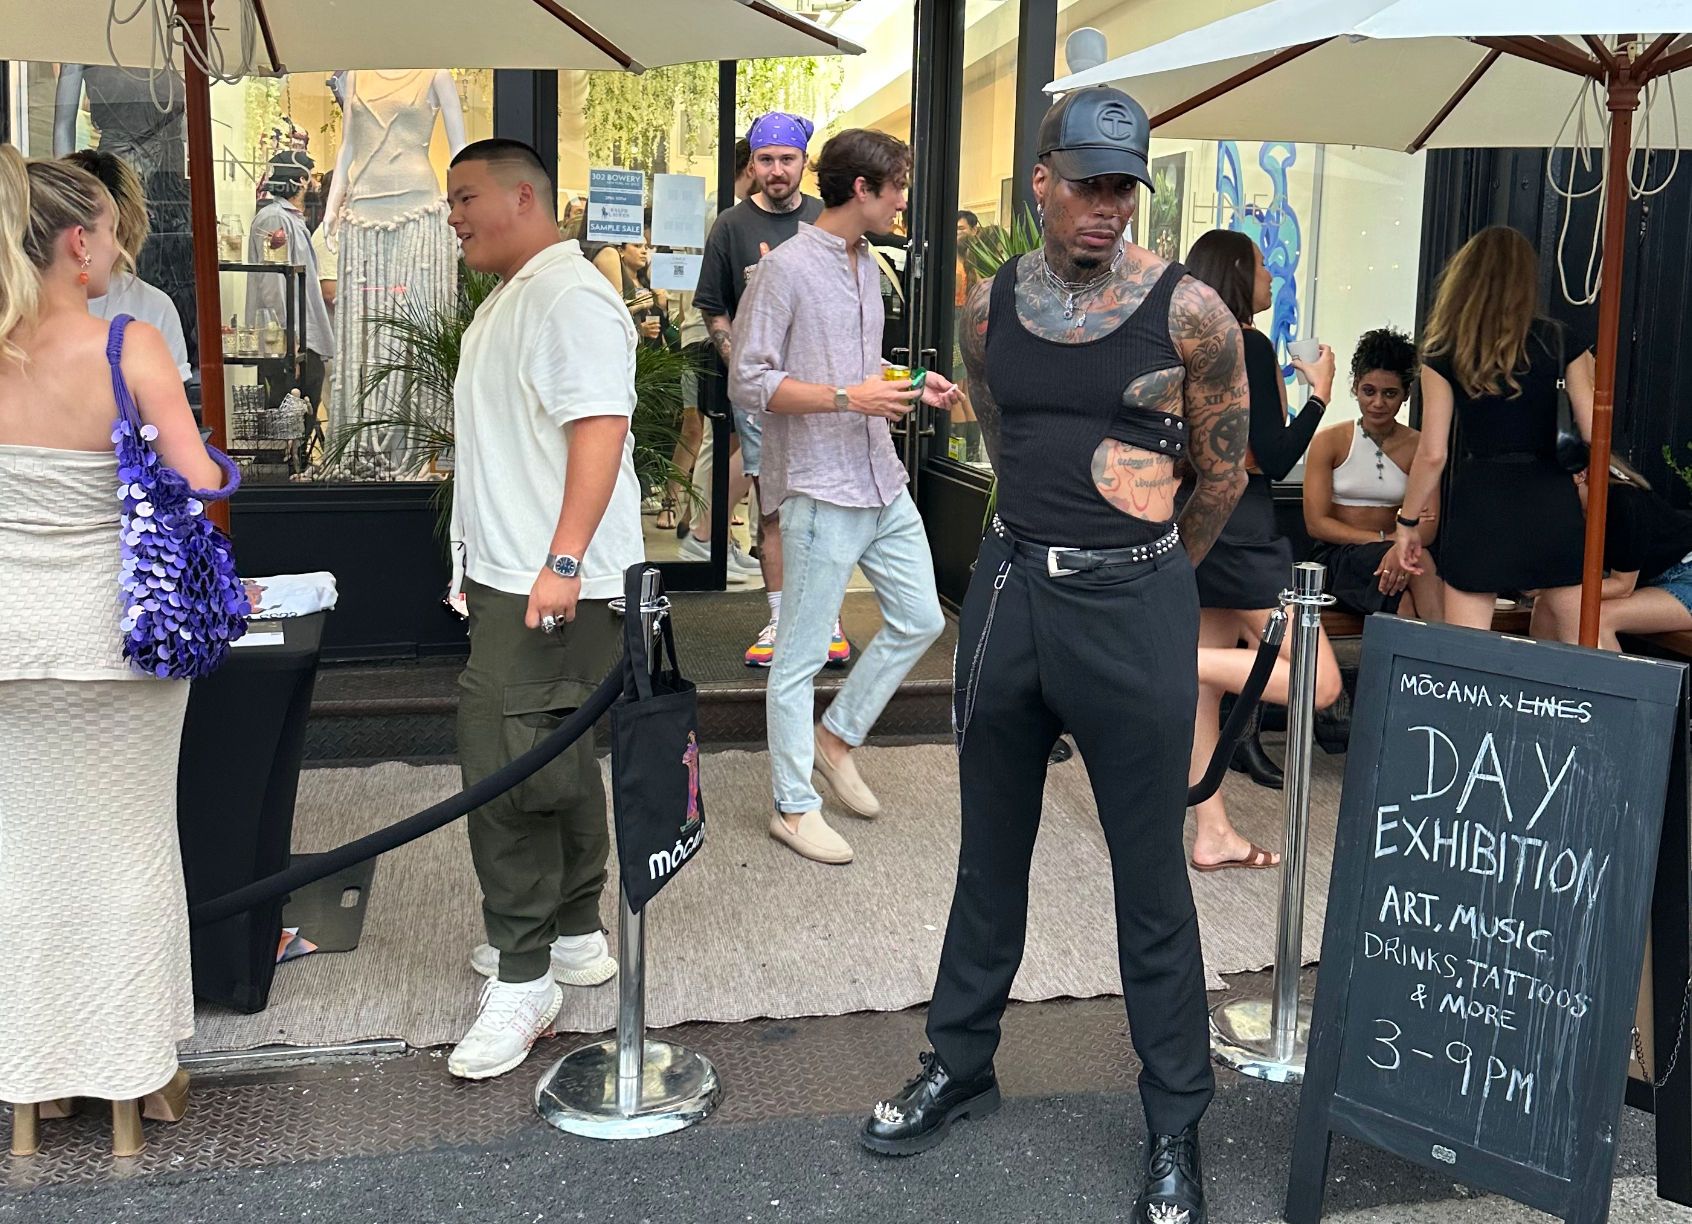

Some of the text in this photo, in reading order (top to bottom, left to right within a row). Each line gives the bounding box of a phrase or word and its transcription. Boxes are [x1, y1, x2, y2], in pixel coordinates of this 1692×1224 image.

[592, 172, 641, 183] 302 BOWERY
[590, 223, 641, 233] SAMPLE SALE
[1192, 191, 1287, 226] LINES
[1516, 691, 1593, 723] LINES
[1408, 725, 1577, 831] DAY
[1374, 804, 1610, 906] EXHIBITION
[1379, 885, 1553, 953] ART, MUSIC
[1410, 983, 1517, 1031] & MORE
